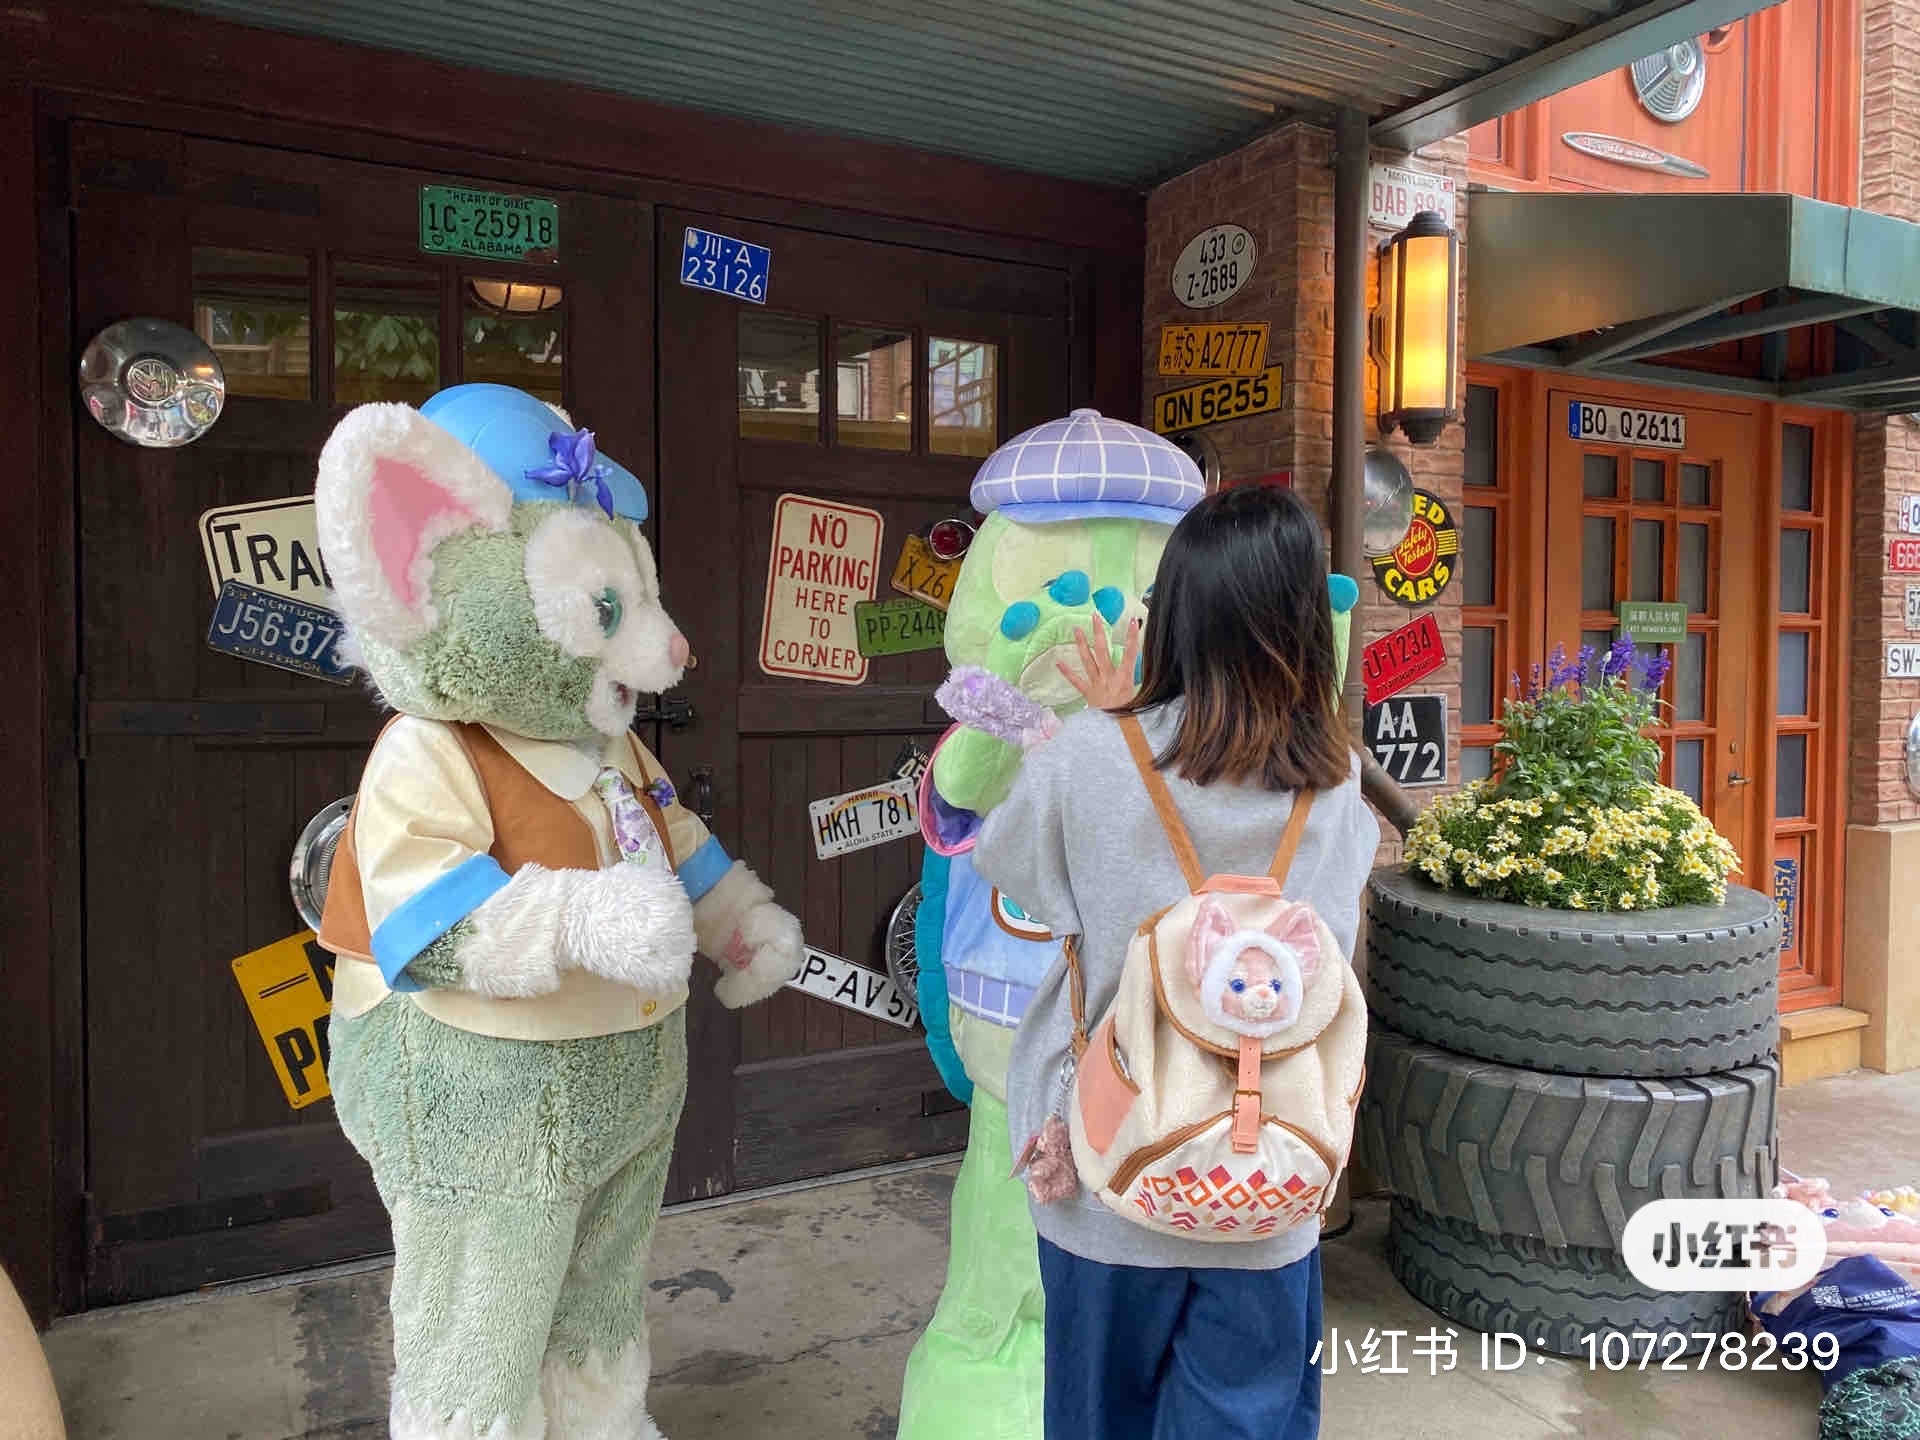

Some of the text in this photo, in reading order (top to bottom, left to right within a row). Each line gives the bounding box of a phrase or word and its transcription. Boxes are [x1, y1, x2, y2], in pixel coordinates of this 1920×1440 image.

[428, 202, 552, 243] 1C-25918
[462, 239, 523, 256] ALABAMA
[1200, 234, 1225, 265] 433
[687, 256, 762, 299] 23126
[1187, 261, 1238, 301] Z-2689
[1164, 374, 1269, 428] QN 6255
[1413, 494, 1446, 525] ED
[809, 512, 848, 549] NO
[778, 546, 870, 591] PARKING
[1402, 538, 1433, 567] Tested
[1384, 561, 1450, 602] CARS
[258, 596, 337, 625] KENTUCKY
[795, 587, 849, 616] HERE
[808, 616, 831, 640] TO
[773, 639, 856, 671] CORNER
[1365, 742, 1440, 780] 772
[818, 792, 912, 846] HKH 781
[871, 829, 894, 841] STATE
